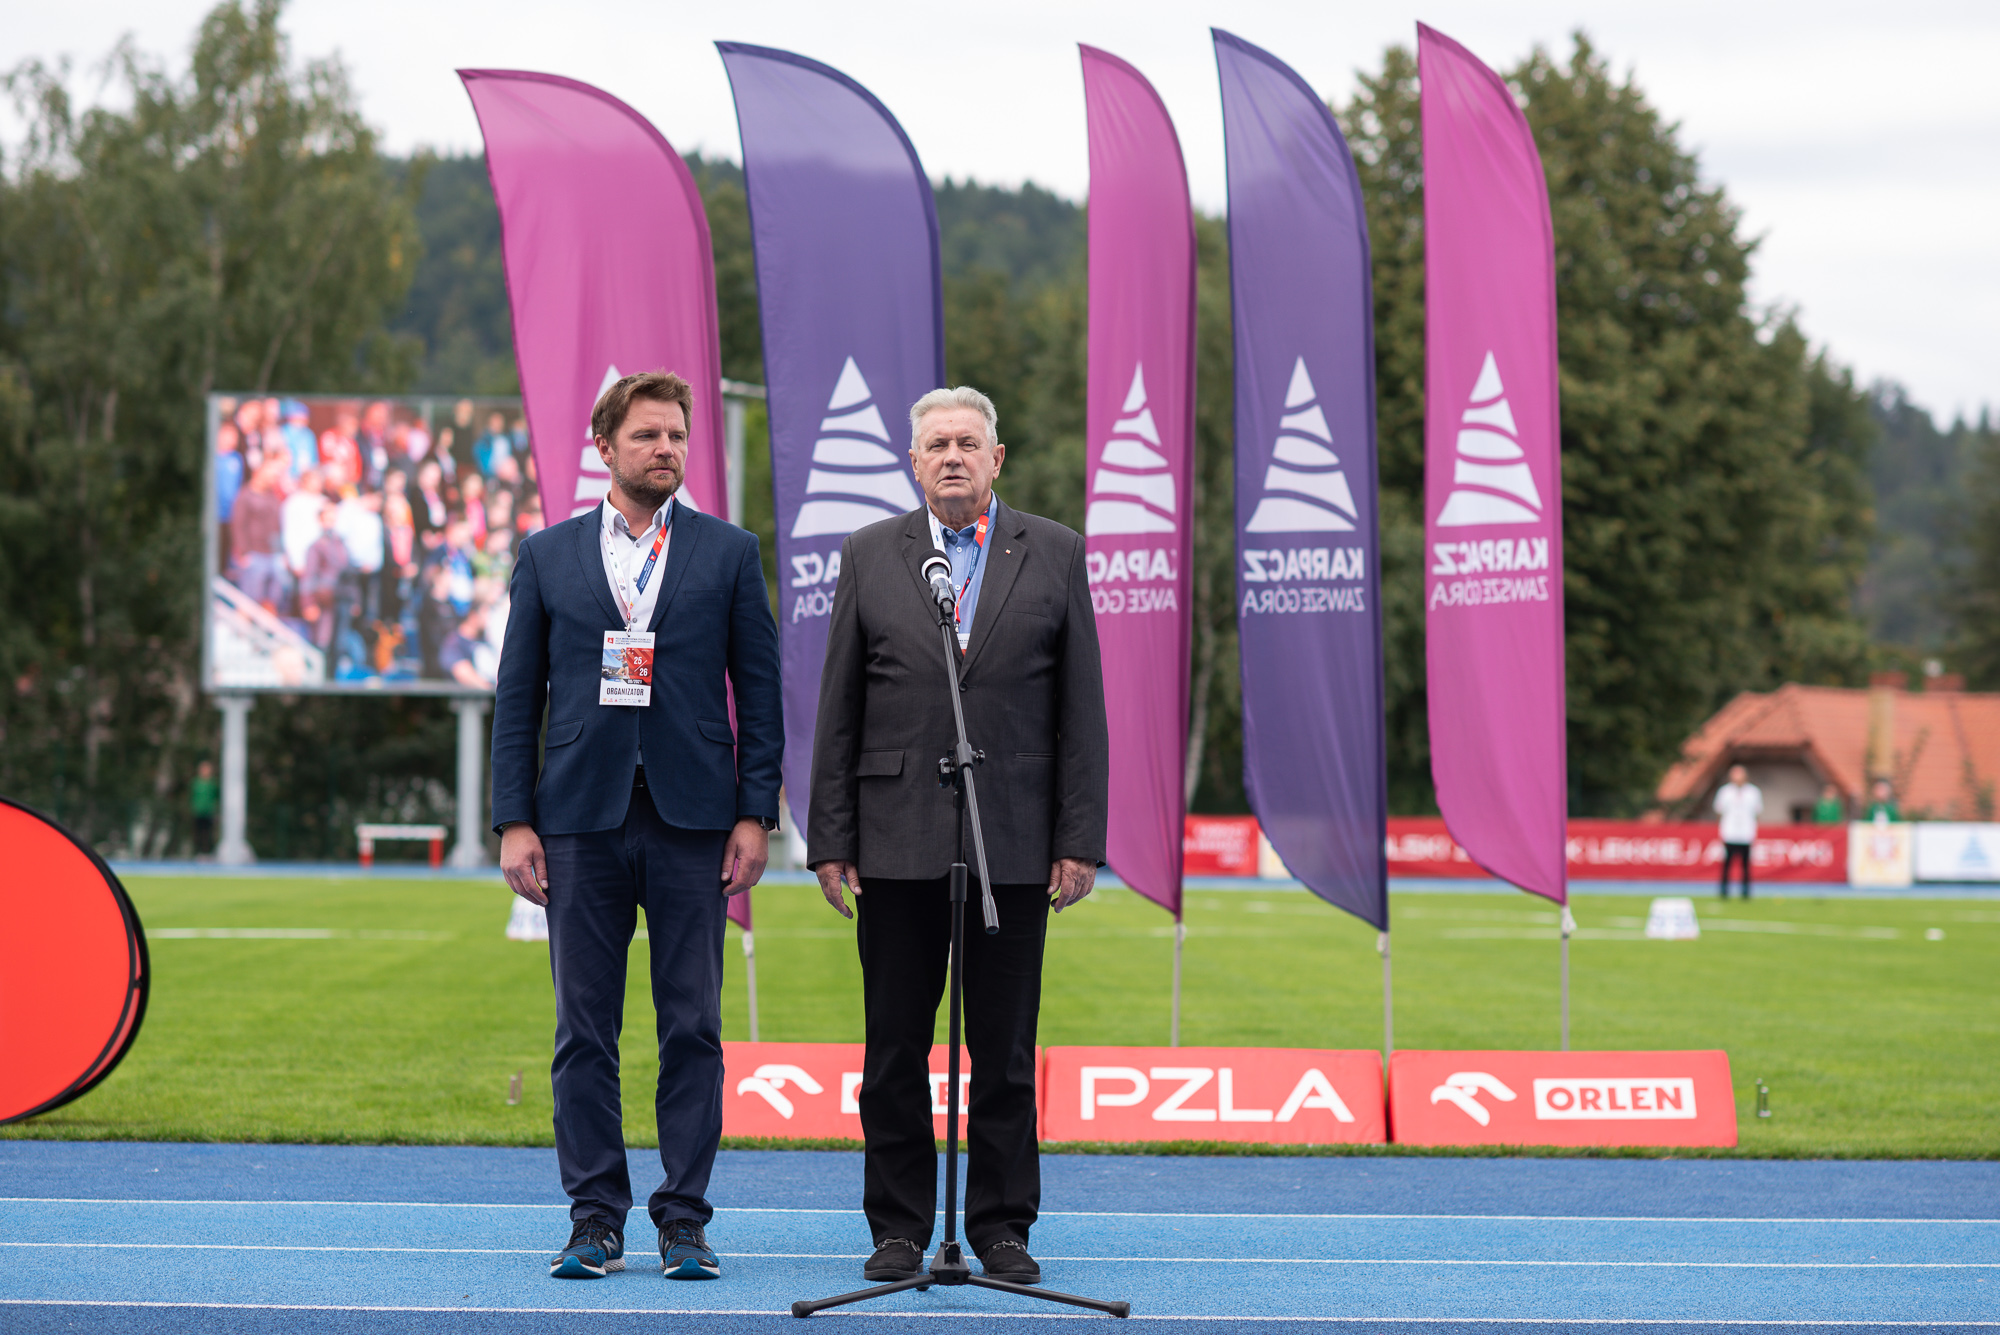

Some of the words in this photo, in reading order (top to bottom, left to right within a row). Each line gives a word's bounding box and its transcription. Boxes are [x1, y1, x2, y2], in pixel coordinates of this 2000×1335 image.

[633, 656, 642, 665] 25
[639, 668, 648, 676] 26
[606, 687, 644, 696] ORGANIZATOR
[1080, 1066, 1355, 1122] PZLA
[1546, 1087, 1683, 1111] ORLEN
